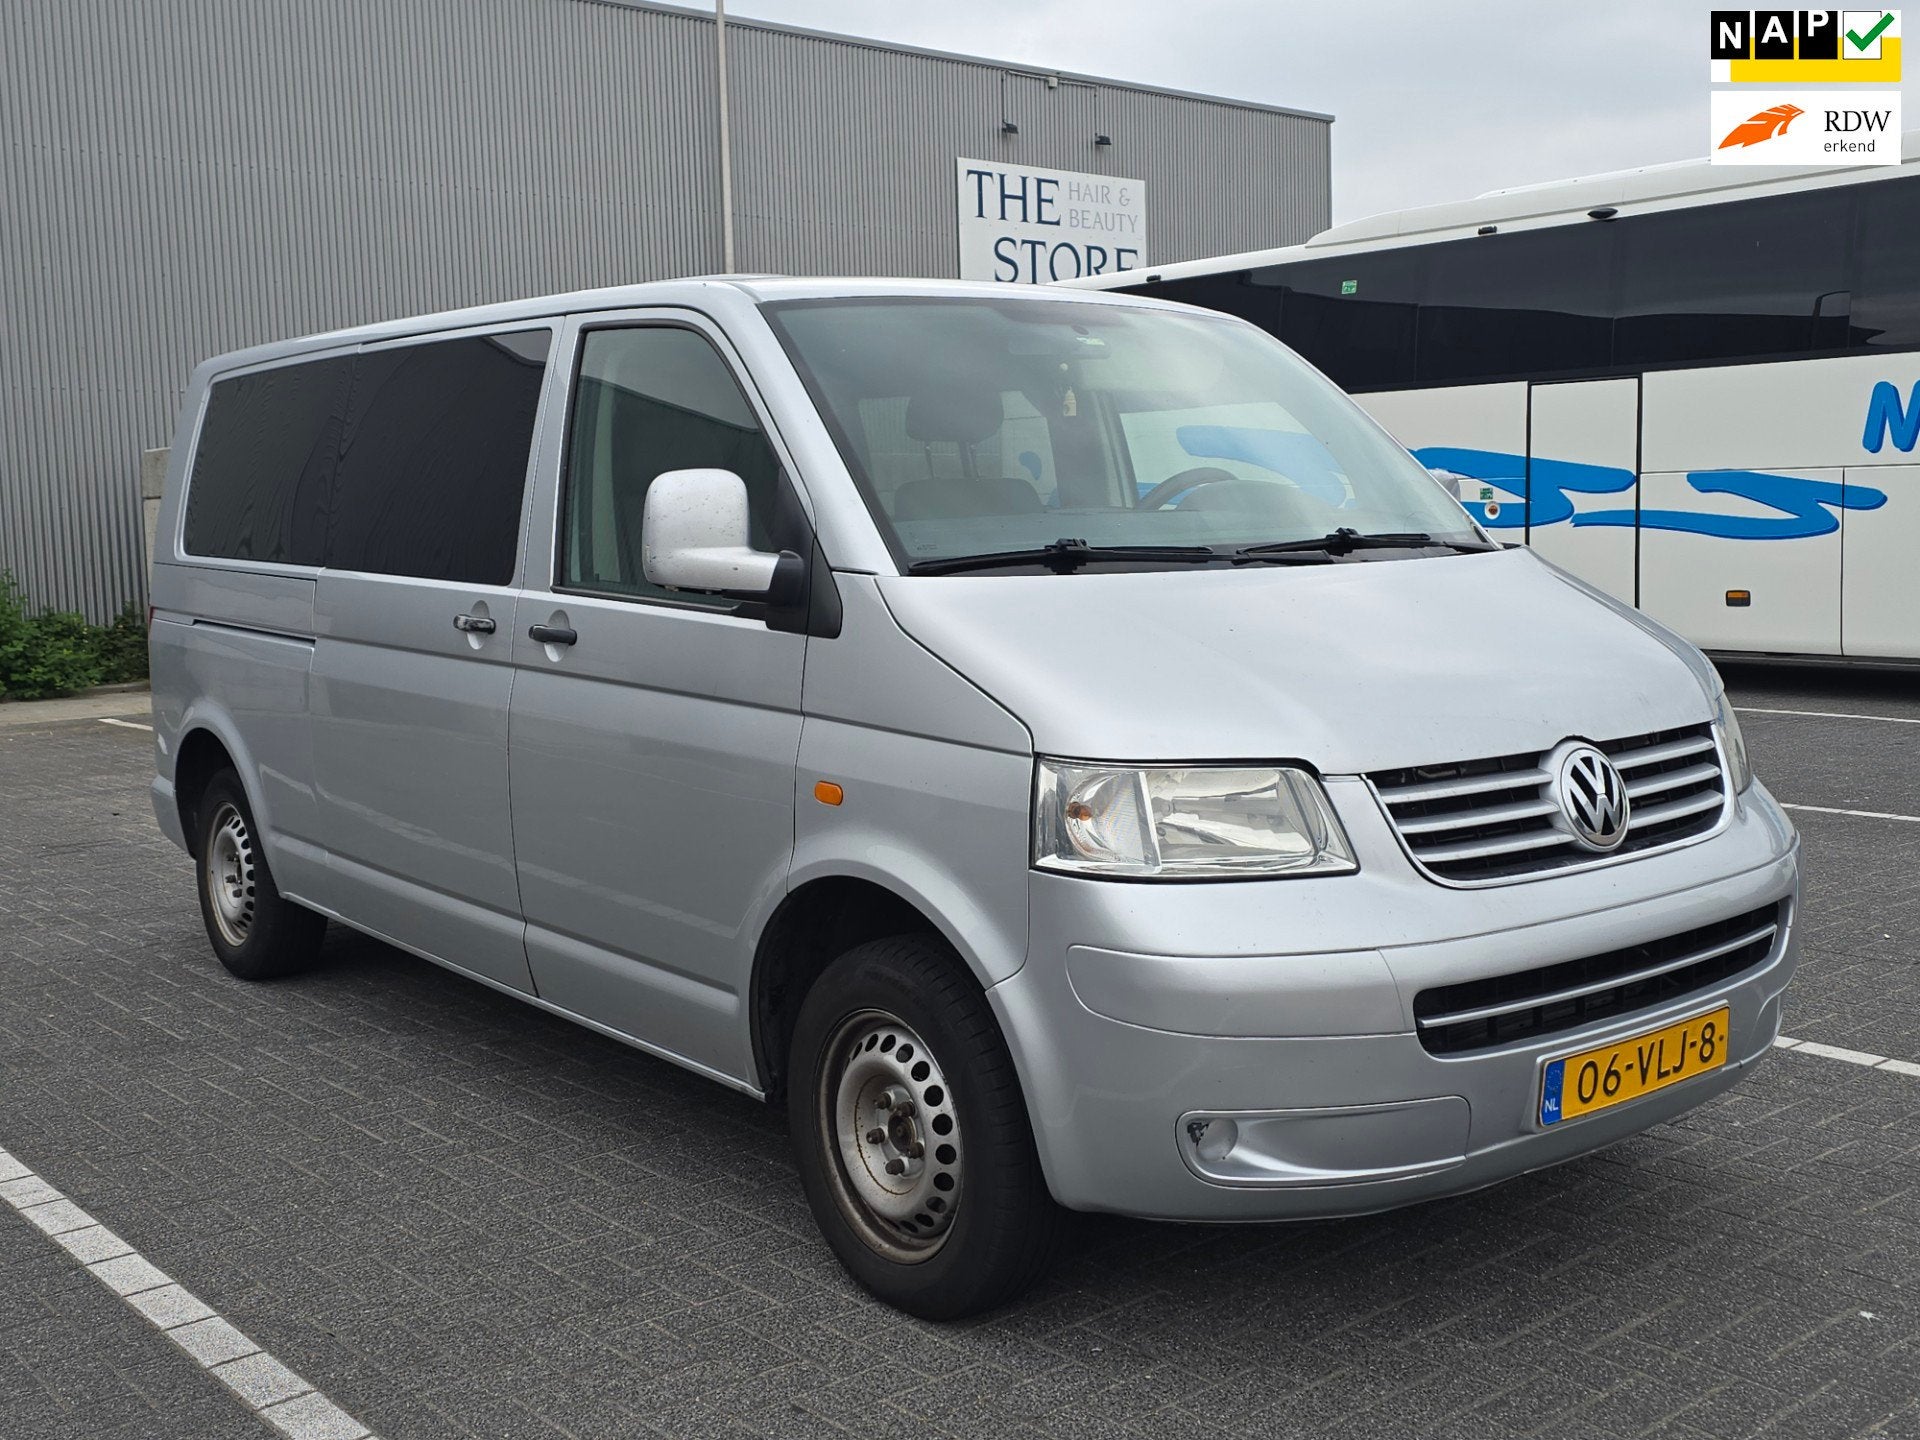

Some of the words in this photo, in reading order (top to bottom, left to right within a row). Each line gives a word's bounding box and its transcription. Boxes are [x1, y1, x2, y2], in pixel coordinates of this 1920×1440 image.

[966, 169, 1061, 226] THE
[1068, 181, 1111, 204] HAIR
[1118, 187, 1131, 207] &
[1069, 208, 1138, 233] BEAUTY
[1577, 1021, 1716, 1104] 06-VLJ-8
[1544, 1098, 1559, 1113] NL
